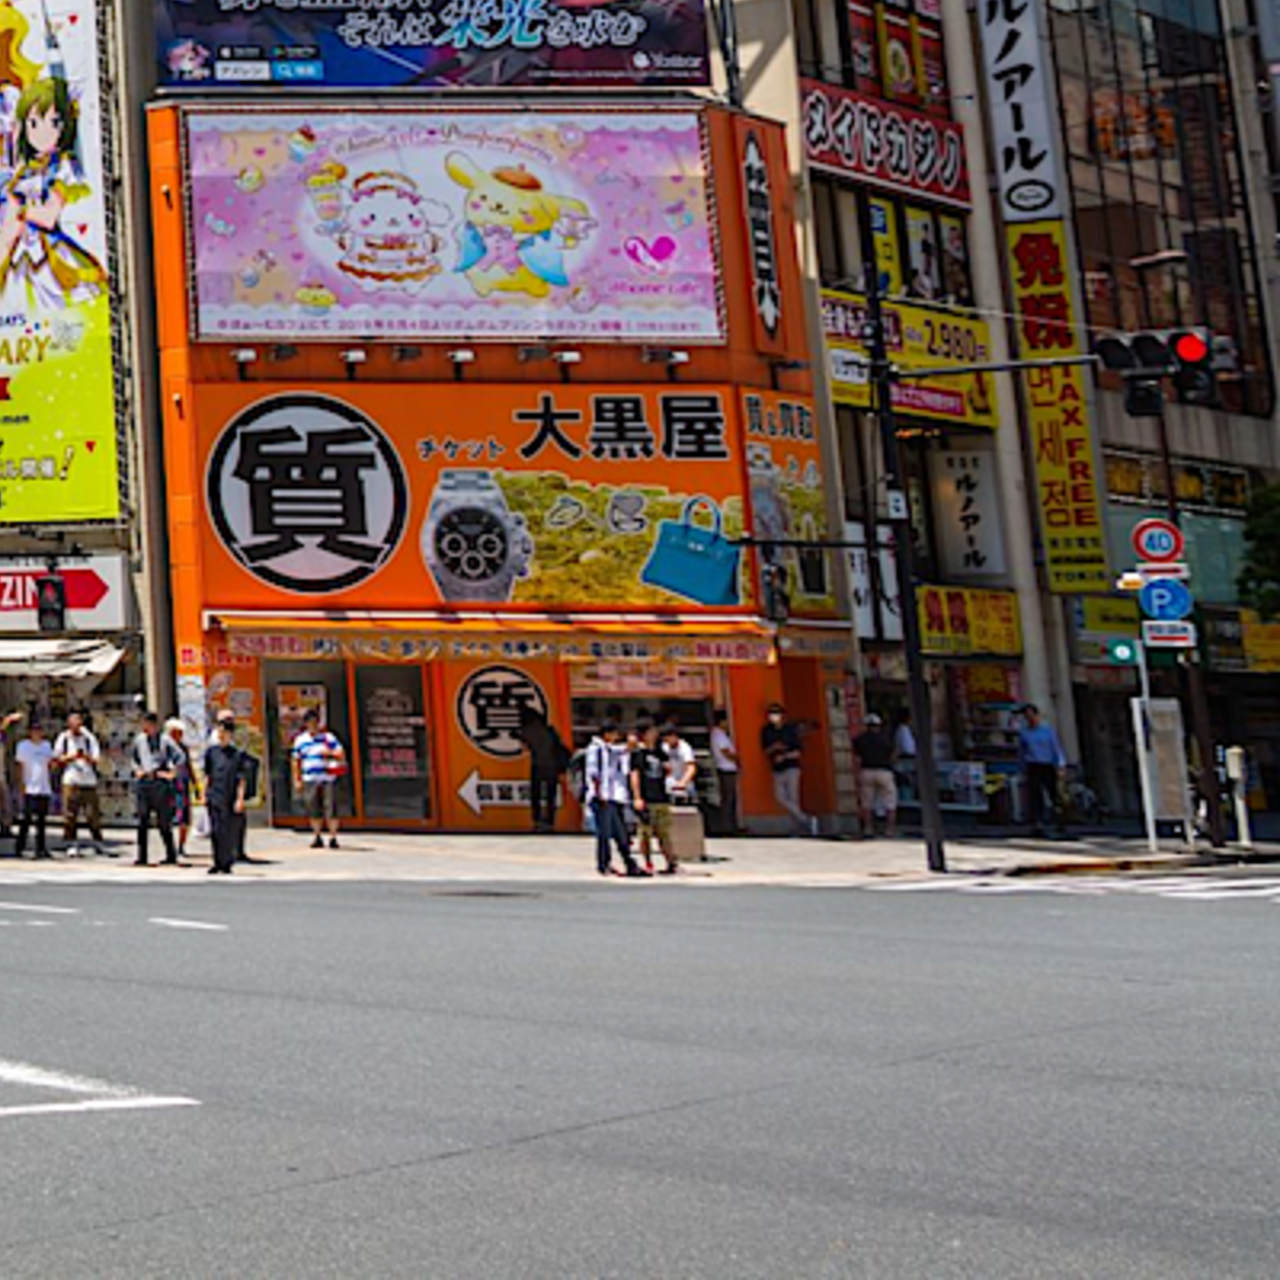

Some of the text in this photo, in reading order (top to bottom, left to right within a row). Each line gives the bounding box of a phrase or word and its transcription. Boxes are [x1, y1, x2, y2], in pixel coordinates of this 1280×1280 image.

[805, 90, 962, 190] メイドカジノ
[1012, 232, 1074, 351] 免税
[418, 436, 506, 461] チケット
[514, 392, 729, 461] 大黒屋
[233, 423, 385, 568] 質
[1065, 437, 1099, 528] FREE
[1144, 533, 1173, 552] 40
[466, 678, 528, 750] 質
